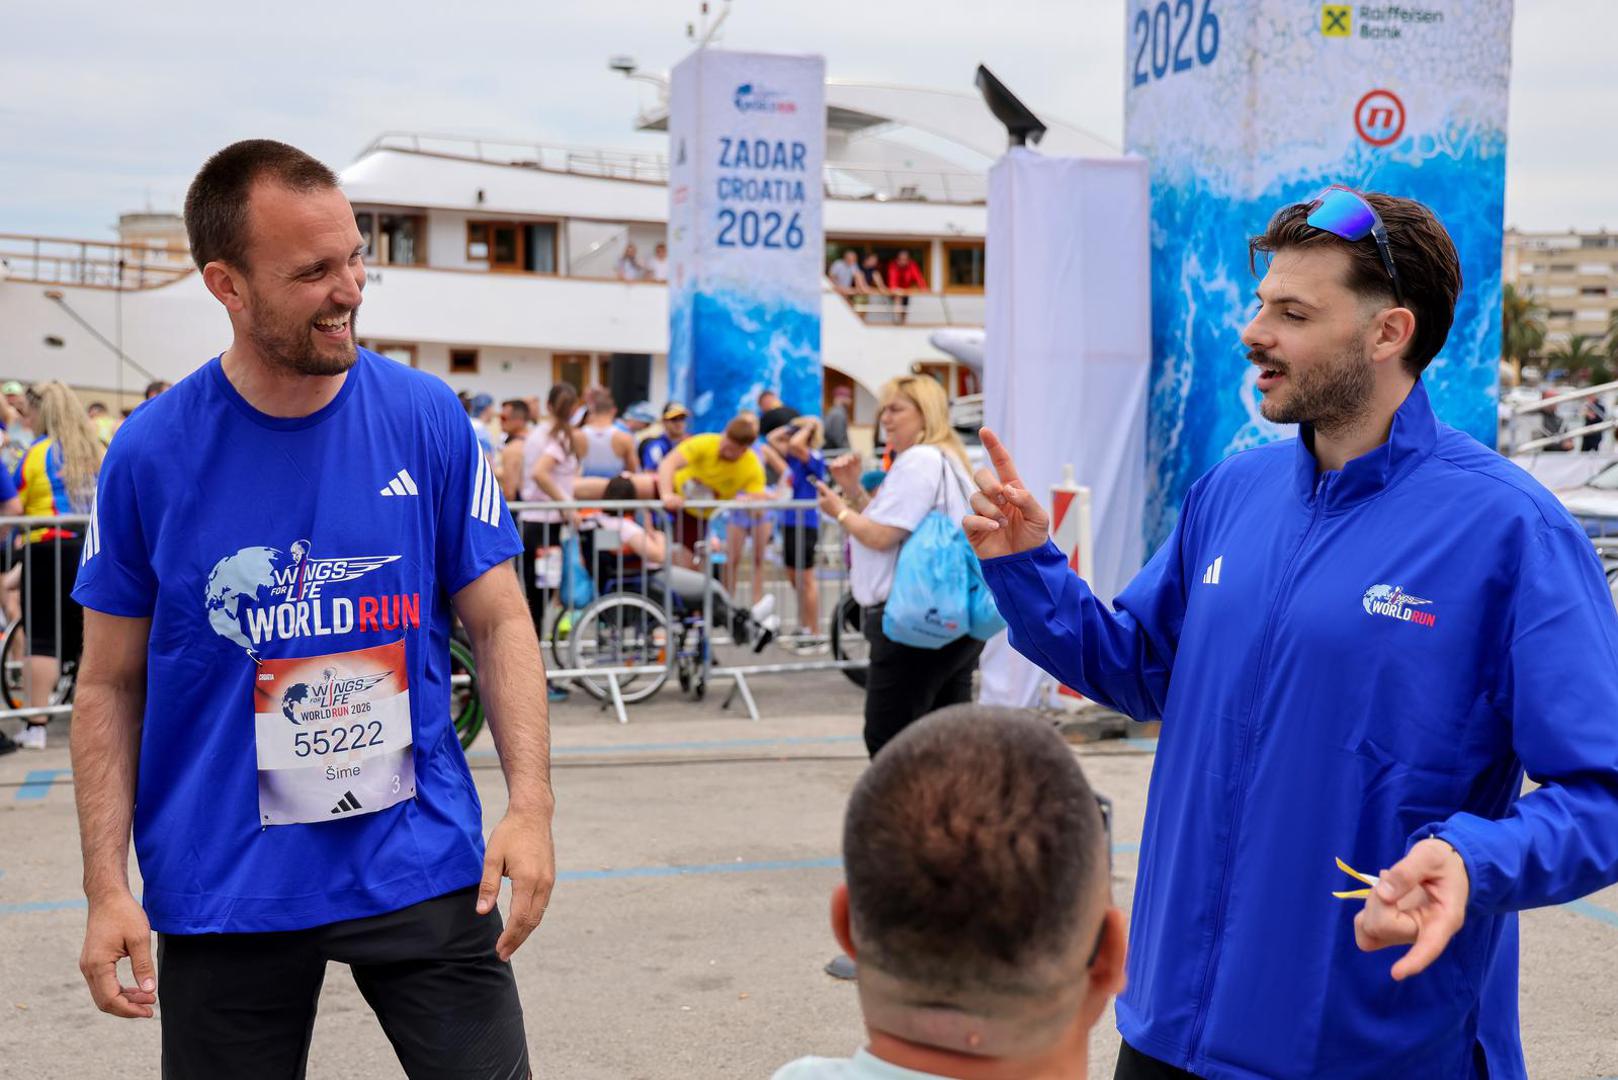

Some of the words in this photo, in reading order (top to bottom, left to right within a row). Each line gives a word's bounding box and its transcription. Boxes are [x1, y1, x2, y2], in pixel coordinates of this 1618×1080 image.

[1360, 24, 1400, 38] Bank
[1133, 0, 1219, 87] 2026
[718, 137, 807, 171] ZADAR
[718, 177, 806, 202] CROATIA
[717, 208, 805, 249] 2026
[274, 560, 348, 586] WINGS
[270, 585, 288, 597] FOR
[285, 579, 325, 602] LIFE
[246, 597, 354, 645] WORLD
[358, 592, 420, 633] RUN
[311, 678, 365, 697] WINGS
[320, 692, 351, 708] LIFE
[350, 702, 372, 715] 2026
[294, 720, 384, 757] 55222
[326, 765, 361, 781] Šime
[391, 775, 401, 794] 3
